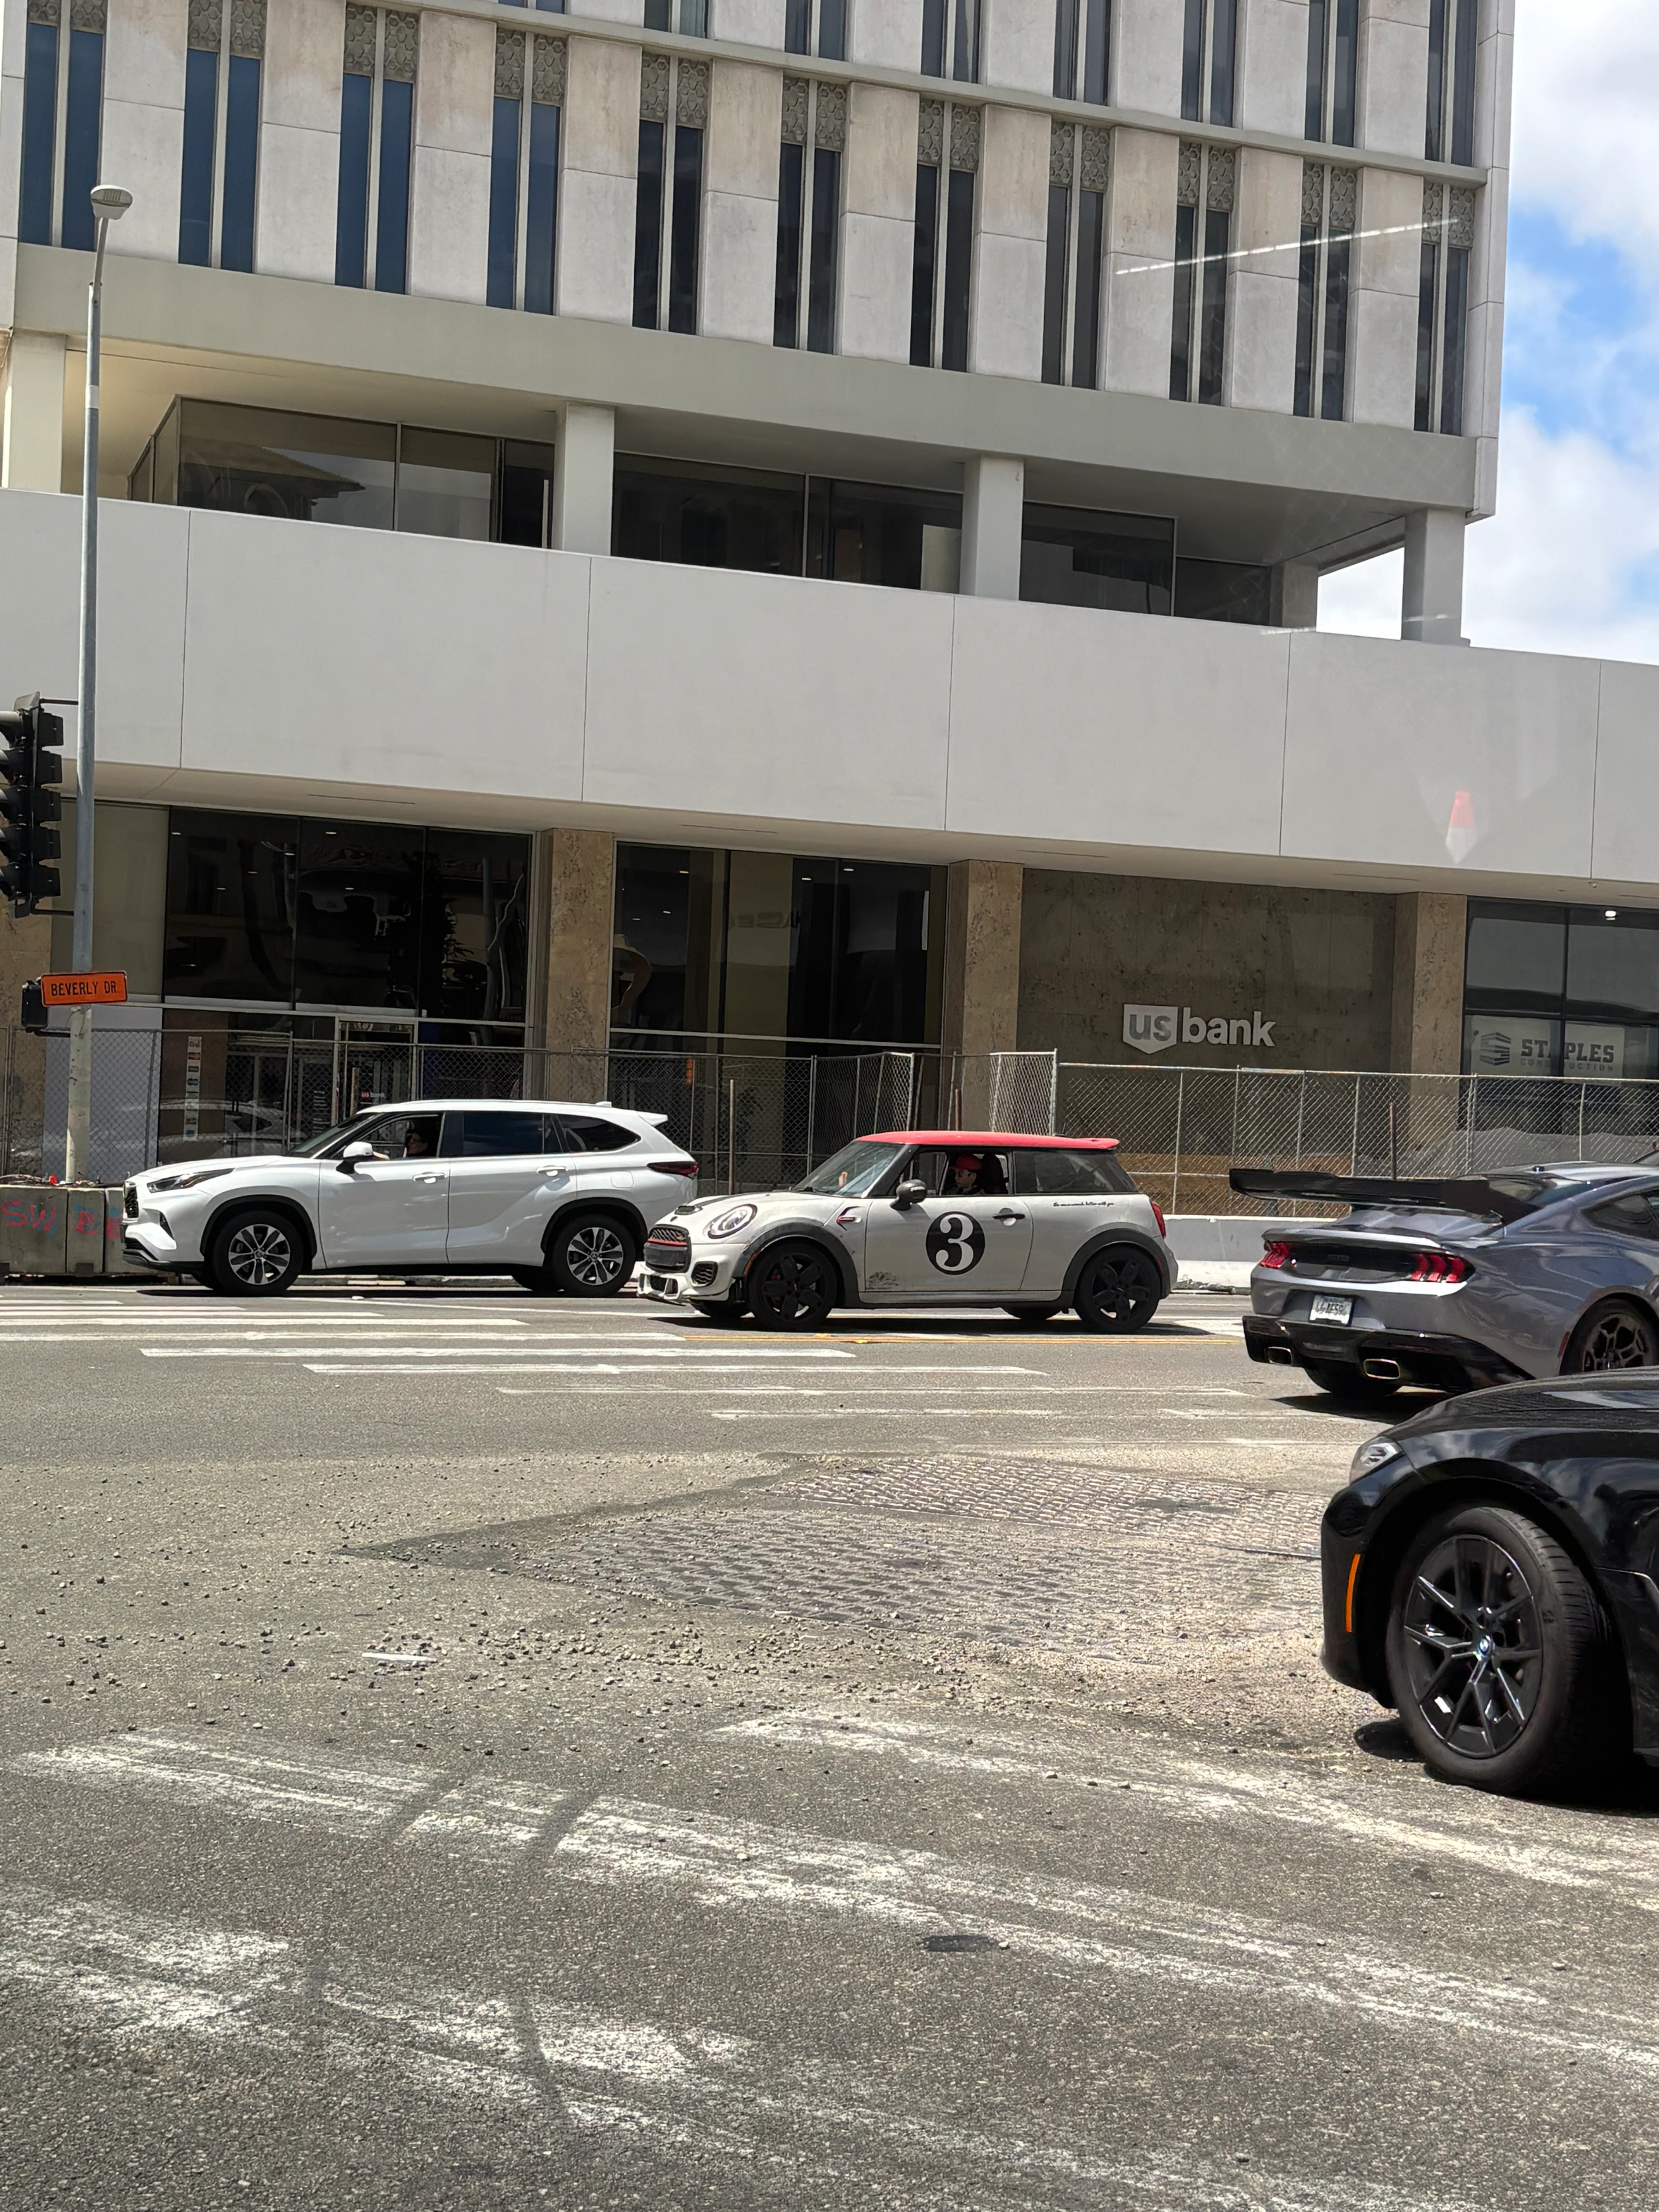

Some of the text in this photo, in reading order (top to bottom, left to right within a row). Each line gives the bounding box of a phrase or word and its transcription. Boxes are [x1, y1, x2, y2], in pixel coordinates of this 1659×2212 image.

[51, 981, 117, 996] BEVERLY DR
[1521, 1039, 1614, 1063] STPLES
[1520, 1058, 1613, 1072] CONSUCTION
[935, 1214, 974, 1271] 3
